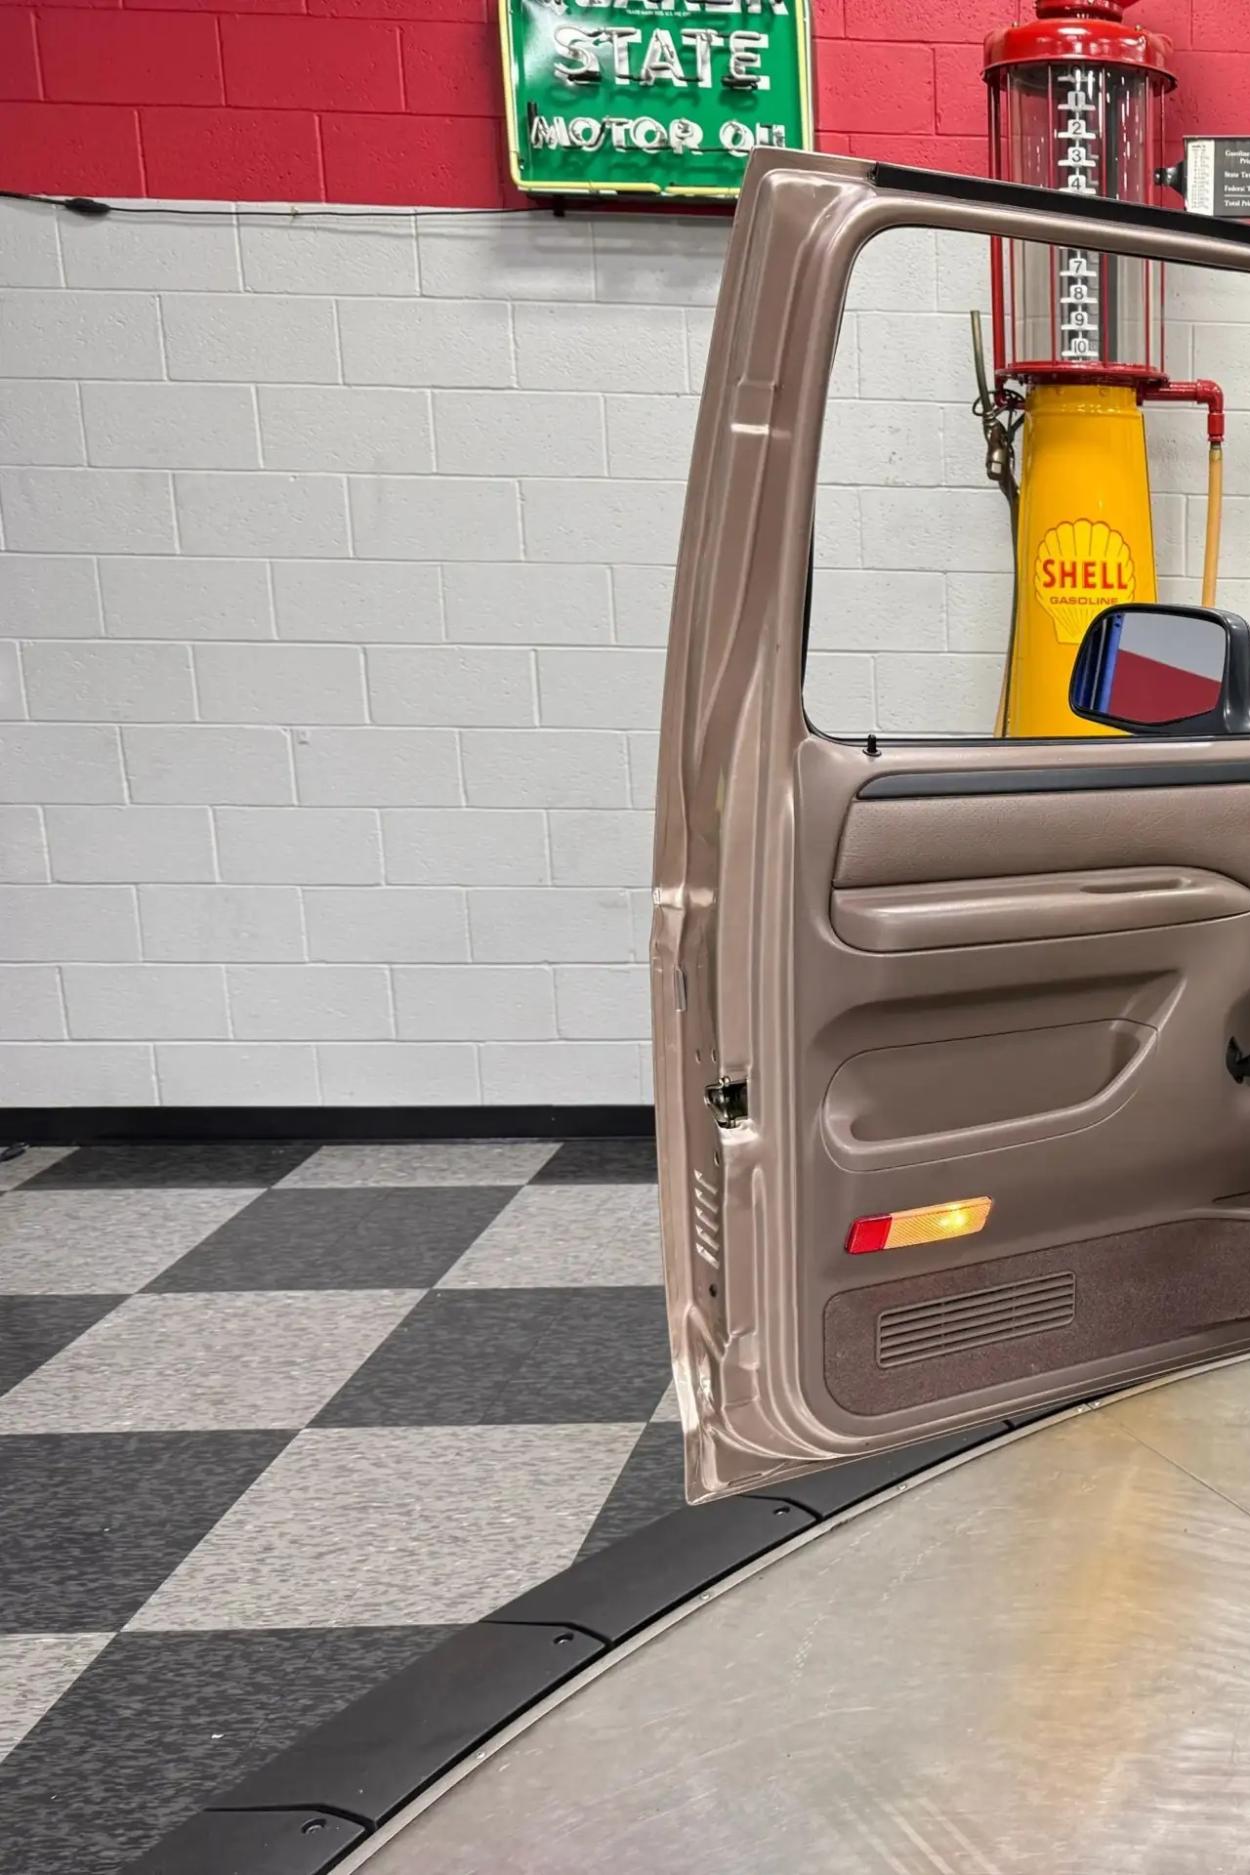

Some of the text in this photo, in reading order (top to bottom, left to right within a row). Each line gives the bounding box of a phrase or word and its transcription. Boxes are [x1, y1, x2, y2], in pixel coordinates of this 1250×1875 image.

[554, 25, 771, 90] STATE
[532, 116, 703, 155] MOTOR
[1073, 340, 1087, 354] 10
[1042, 559, 1128, 589] SHELL
[1050, 596, 1119, 606] GASOLINE
